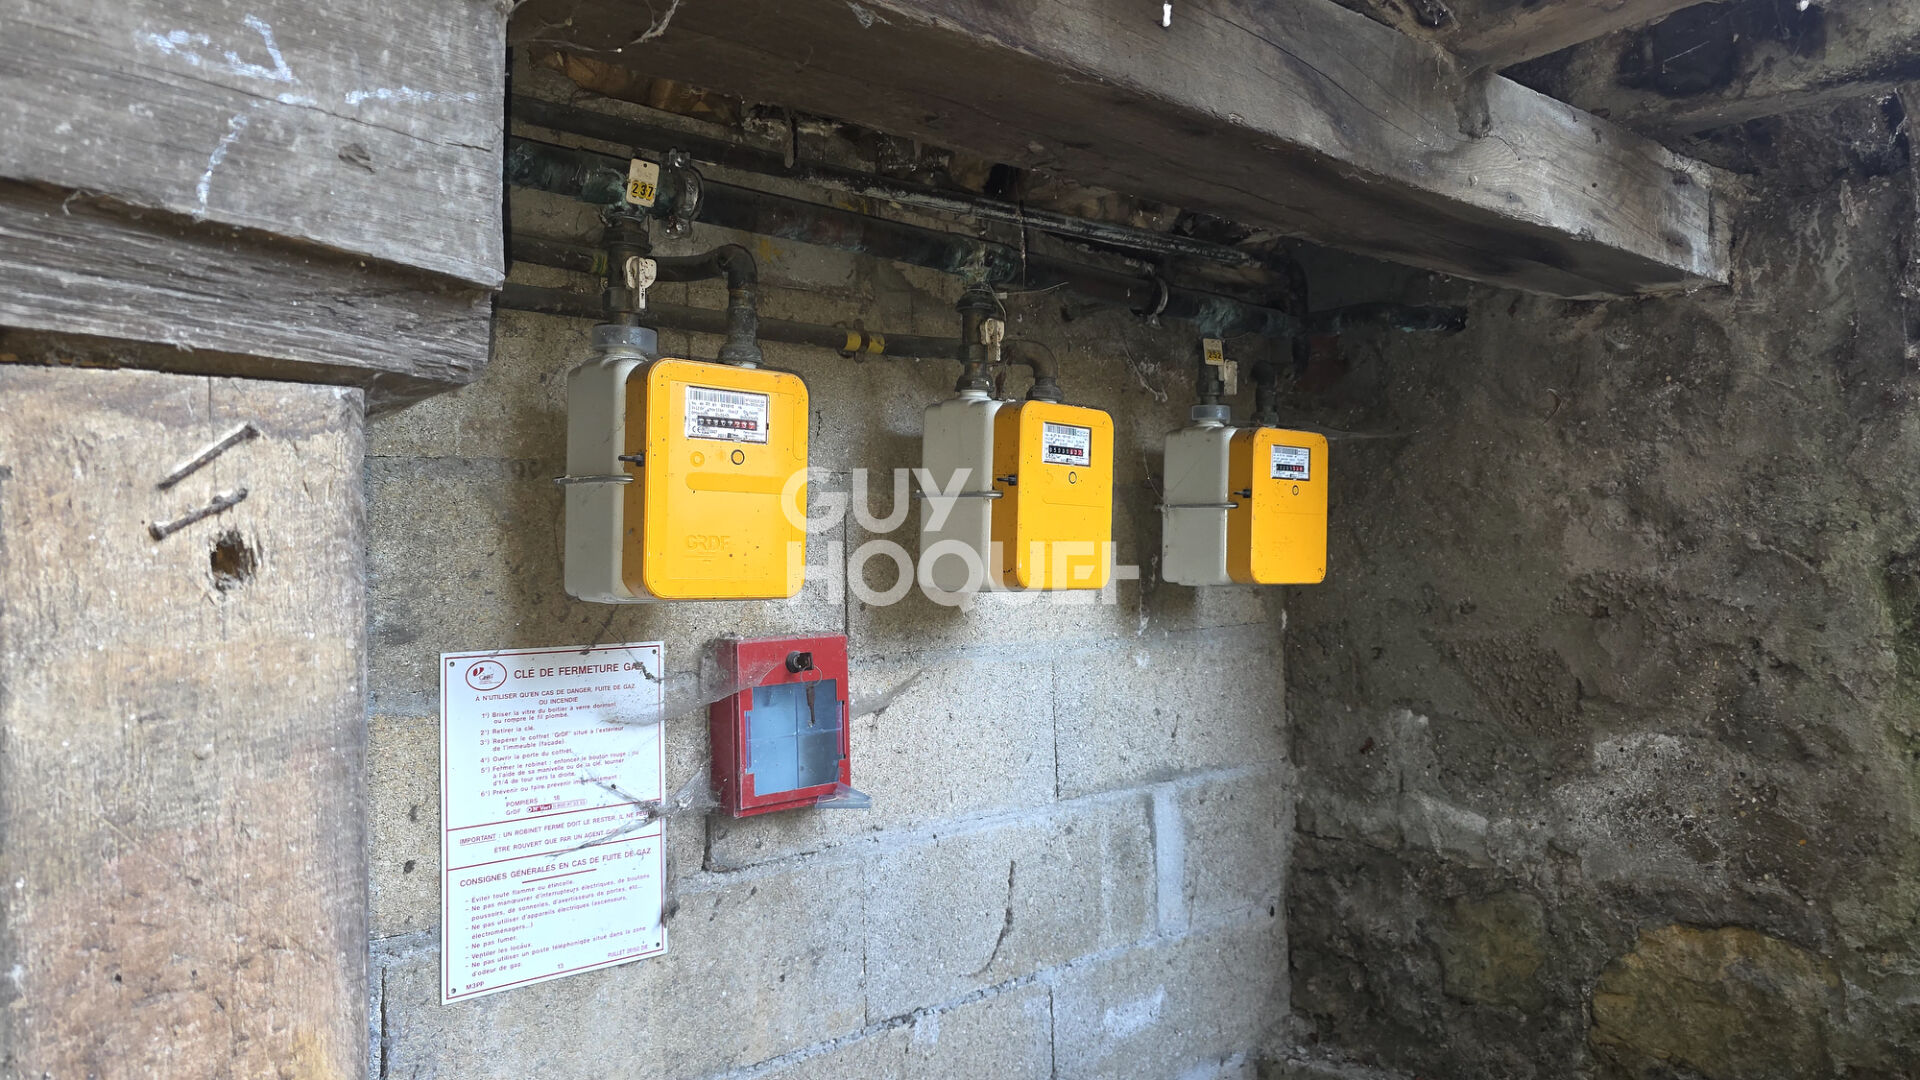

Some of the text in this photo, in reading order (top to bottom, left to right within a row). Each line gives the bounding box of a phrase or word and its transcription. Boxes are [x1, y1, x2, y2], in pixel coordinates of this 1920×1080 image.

[632, 183, 654, 197] 237
[514, 667, 534, 679] CLÉ
[540, 668, 554, 678] DE
[558, 664, 619, 675] FERMETURE
[503, 742, 536, 750] l'immeuble
[537, 766, 564, 774] manivelle
[506, 798, 538, 807] POMPIERS
[460, 834, 496, 844] IMPORTANT
[515, 826, 542, 835] ROBINET
[513, 840, 542, 850] ROUVERT
[584, 830, 604, 839] AGENT
[460, 873, 507, 887] CONSIGNES
[572, 859, 587, 867] CAS
[602, 853, 621, 862] FUITE
[497, 917, 519, 925] utiliser
[472, 950, 496, 959] Ventiler
[497, 953, 519, 962] utiliser
[472, 968, 496, 977] d'odeur
